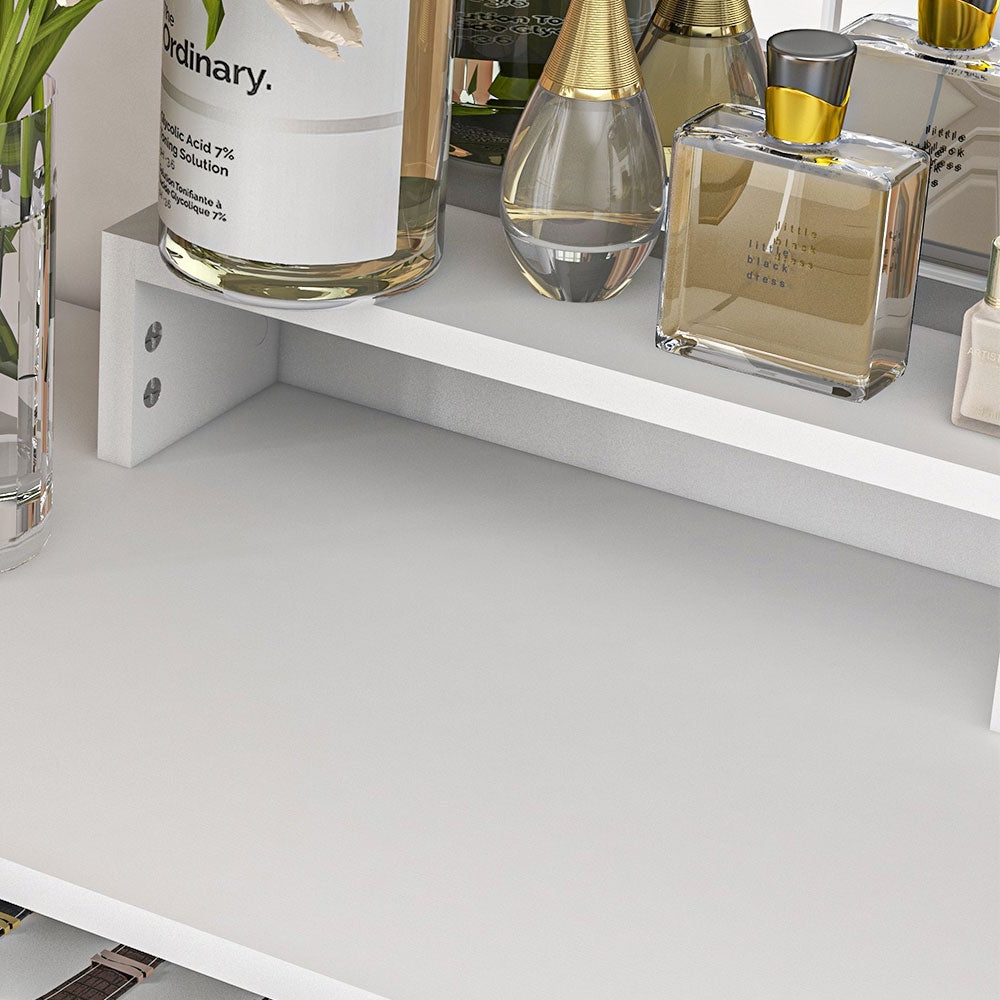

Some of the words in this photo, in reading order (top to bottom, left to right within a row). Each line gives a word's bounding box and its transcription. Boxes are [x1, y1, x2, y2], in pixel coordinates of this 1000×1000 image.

[163, 23, 272, 96] Ordinary.
[186, 134, 212, 154] Acid
[214, 146, 235, 160] 7%
[179, 148, 229, 176] Solution
[170, 190, 211, 216] Glycolique
[212, 211, 227, 222] 7%
[175, 181, 214, 207] Tonifiante
[215, 199, 222, 209] à
[748, 239, 789, 257] little
[746, 254, 788, 274] black
[746, 271, 785, 288] dress
